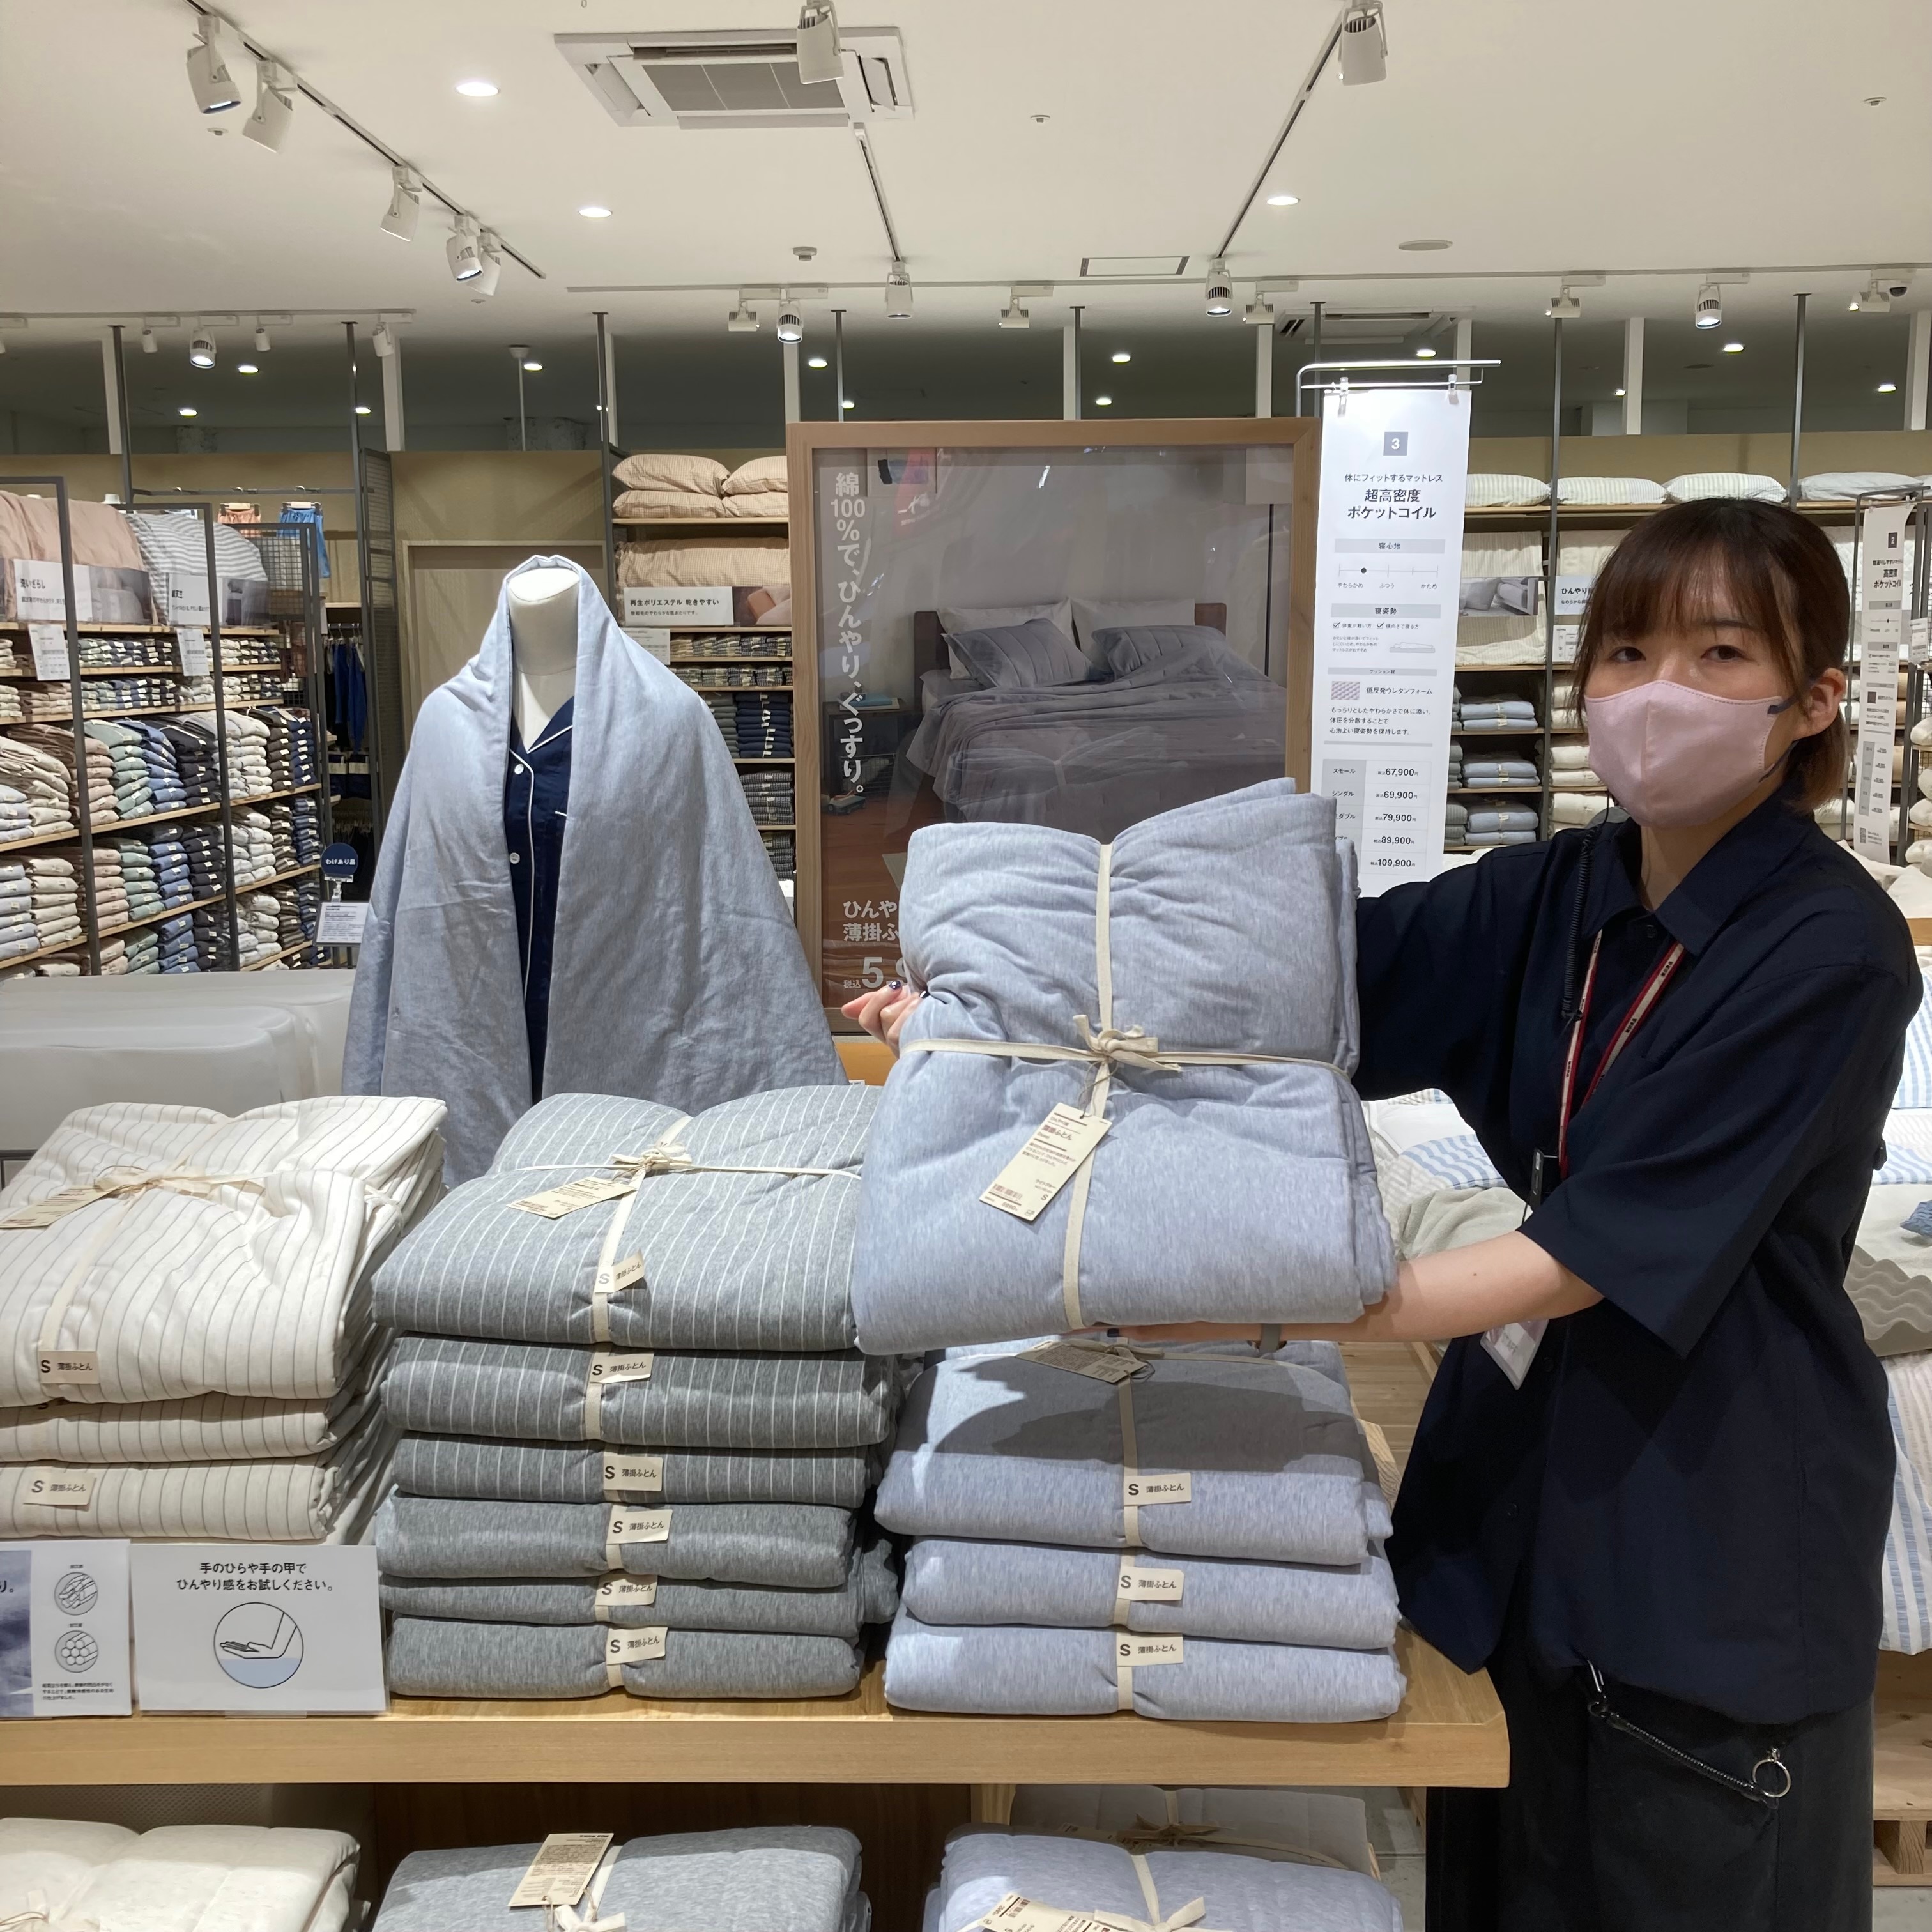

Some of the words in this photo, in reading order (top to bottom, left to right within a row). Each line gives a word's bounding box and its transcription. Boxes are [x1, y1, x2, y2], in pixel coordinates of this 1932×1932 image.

[1392, 438, 1400, 450] 3
[1344, 473, 1443, 483] 体にフィットするマットレス
[1364, 489, 1422, 503] 超高密度
[1347, 506, 1437, 519] ポケットコイル
[831, 473, 866, 793] 綿100%で、ひんやり、ぐっすり。
[843, 900, 898, 919] ひんや
[598, 1273, 610, 1284] S
[40, 1360, 51, 1374] S
[592, 1364, 603, 1376] S
[610, 1361, 646, 1372] 薄掛ふとん
[605, 1466, 615, 1480] S
[622, 1469, 657, 1478] 薄掛ふとん
[31, 1480, 44, 1493] S
[1128, 1483, 1139, 1496] S
[1146, 1483, 1184, 1493] 薄掛ふとん
[612, 1521, 624, 1534] S
[629, 1521, 664, 1531] 薄掛ふとん
[199, 1563, 307, 1574] 手のひらや手の甲で
[176, 1579, 333, 1591] ひんやり感をお試しください。
[602, 1582, 613, 1595] S
[618, 1584, 653, 1593] 薄掛ふとん
[1120, 1575, 1132, 1589] S
[1138, 1579, 1177, 1590] 薄掛ふとん
[610, 1639, 621, 1653] S
[627, 1636, 661, 1650] 薄掛ふとん
[1119, 1644, 1131, 1657] S
[1137, 1644, 1177, 1654] 薄掛ふとん
